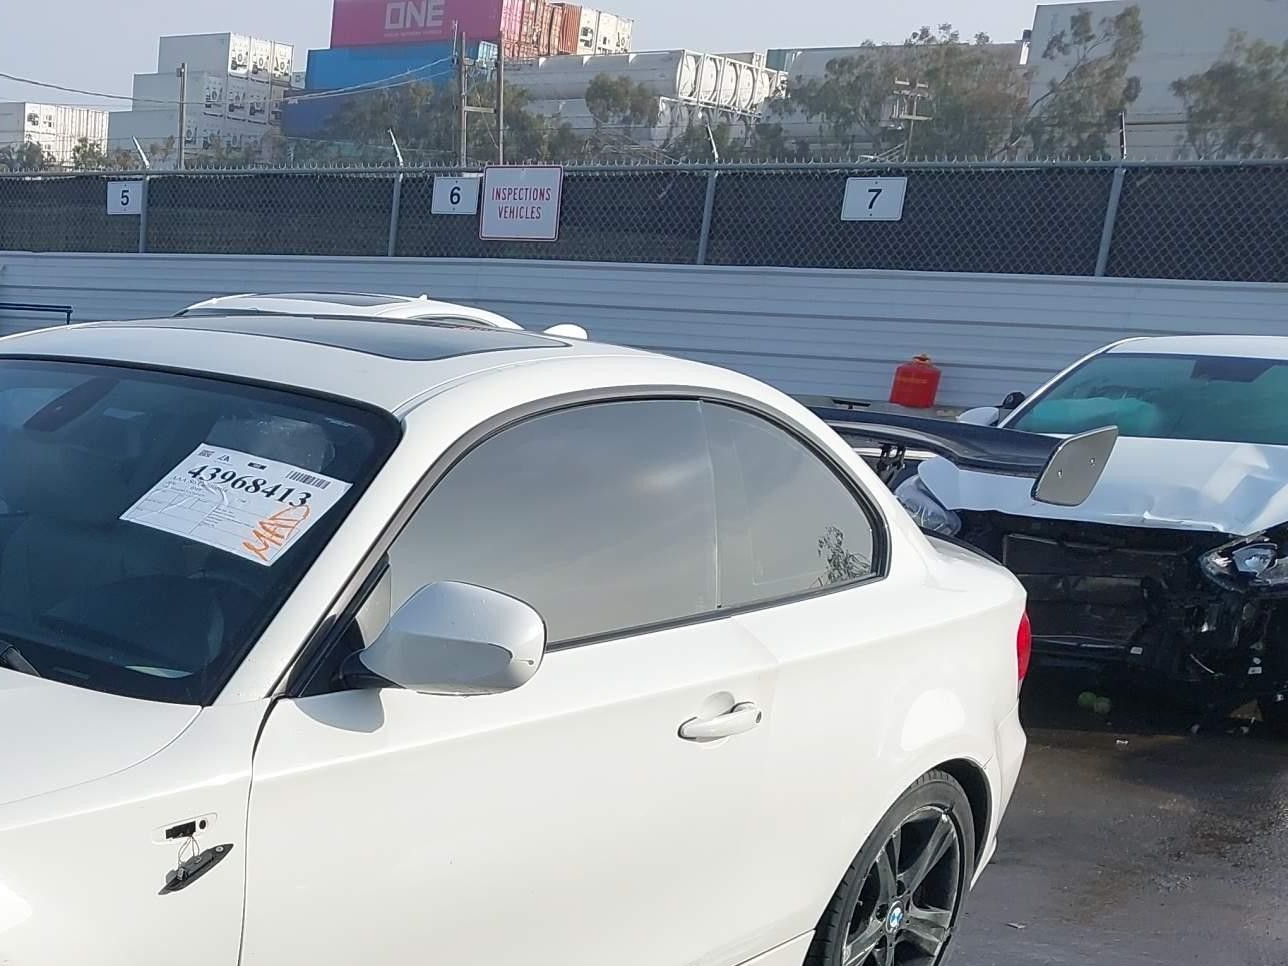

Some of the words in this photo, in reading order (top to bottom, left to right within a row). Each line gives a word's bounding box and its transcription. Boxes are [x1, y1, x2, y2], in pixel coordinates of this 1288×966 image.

[384, 0, 445, 29] ONE
[120, 189, 130, 206] 5
[449, 186, 461, 205] 6
[491, 187, 552, 201] INSPECTIONS
[868, 188, 882, 210] 7
[497, 205, 542, 219] VEHICLES
[187, 464, 313, 508] 43968413
